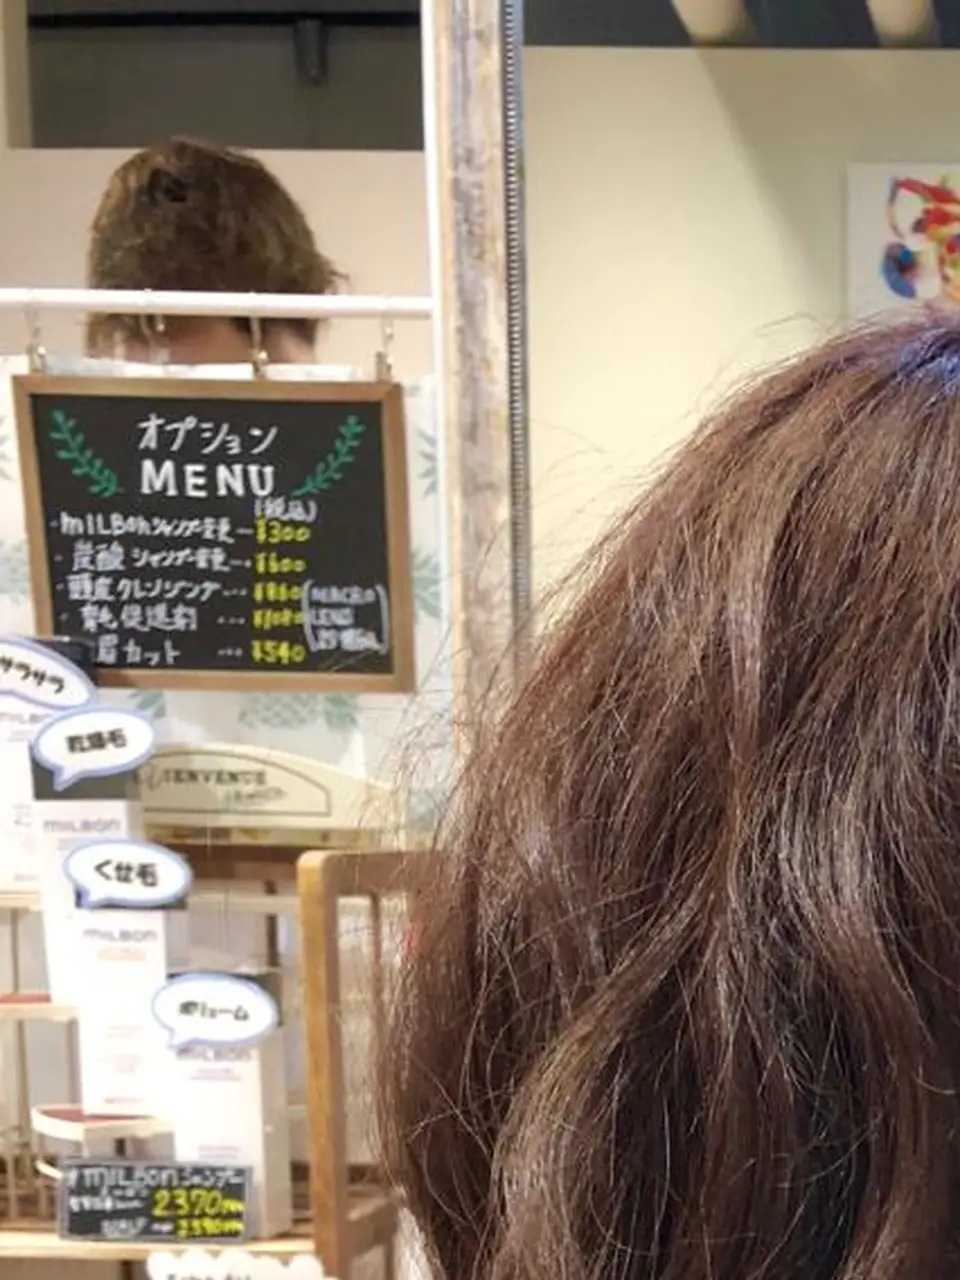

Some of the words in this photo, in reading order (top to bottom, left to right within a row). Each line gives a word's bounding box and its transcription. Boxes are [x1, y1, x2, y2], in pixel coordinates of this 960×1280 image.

[137, 413, 278, 454] オプション
[140, 459, 275, 497] MENU
[94, 859, 158, 887] くせ毛
